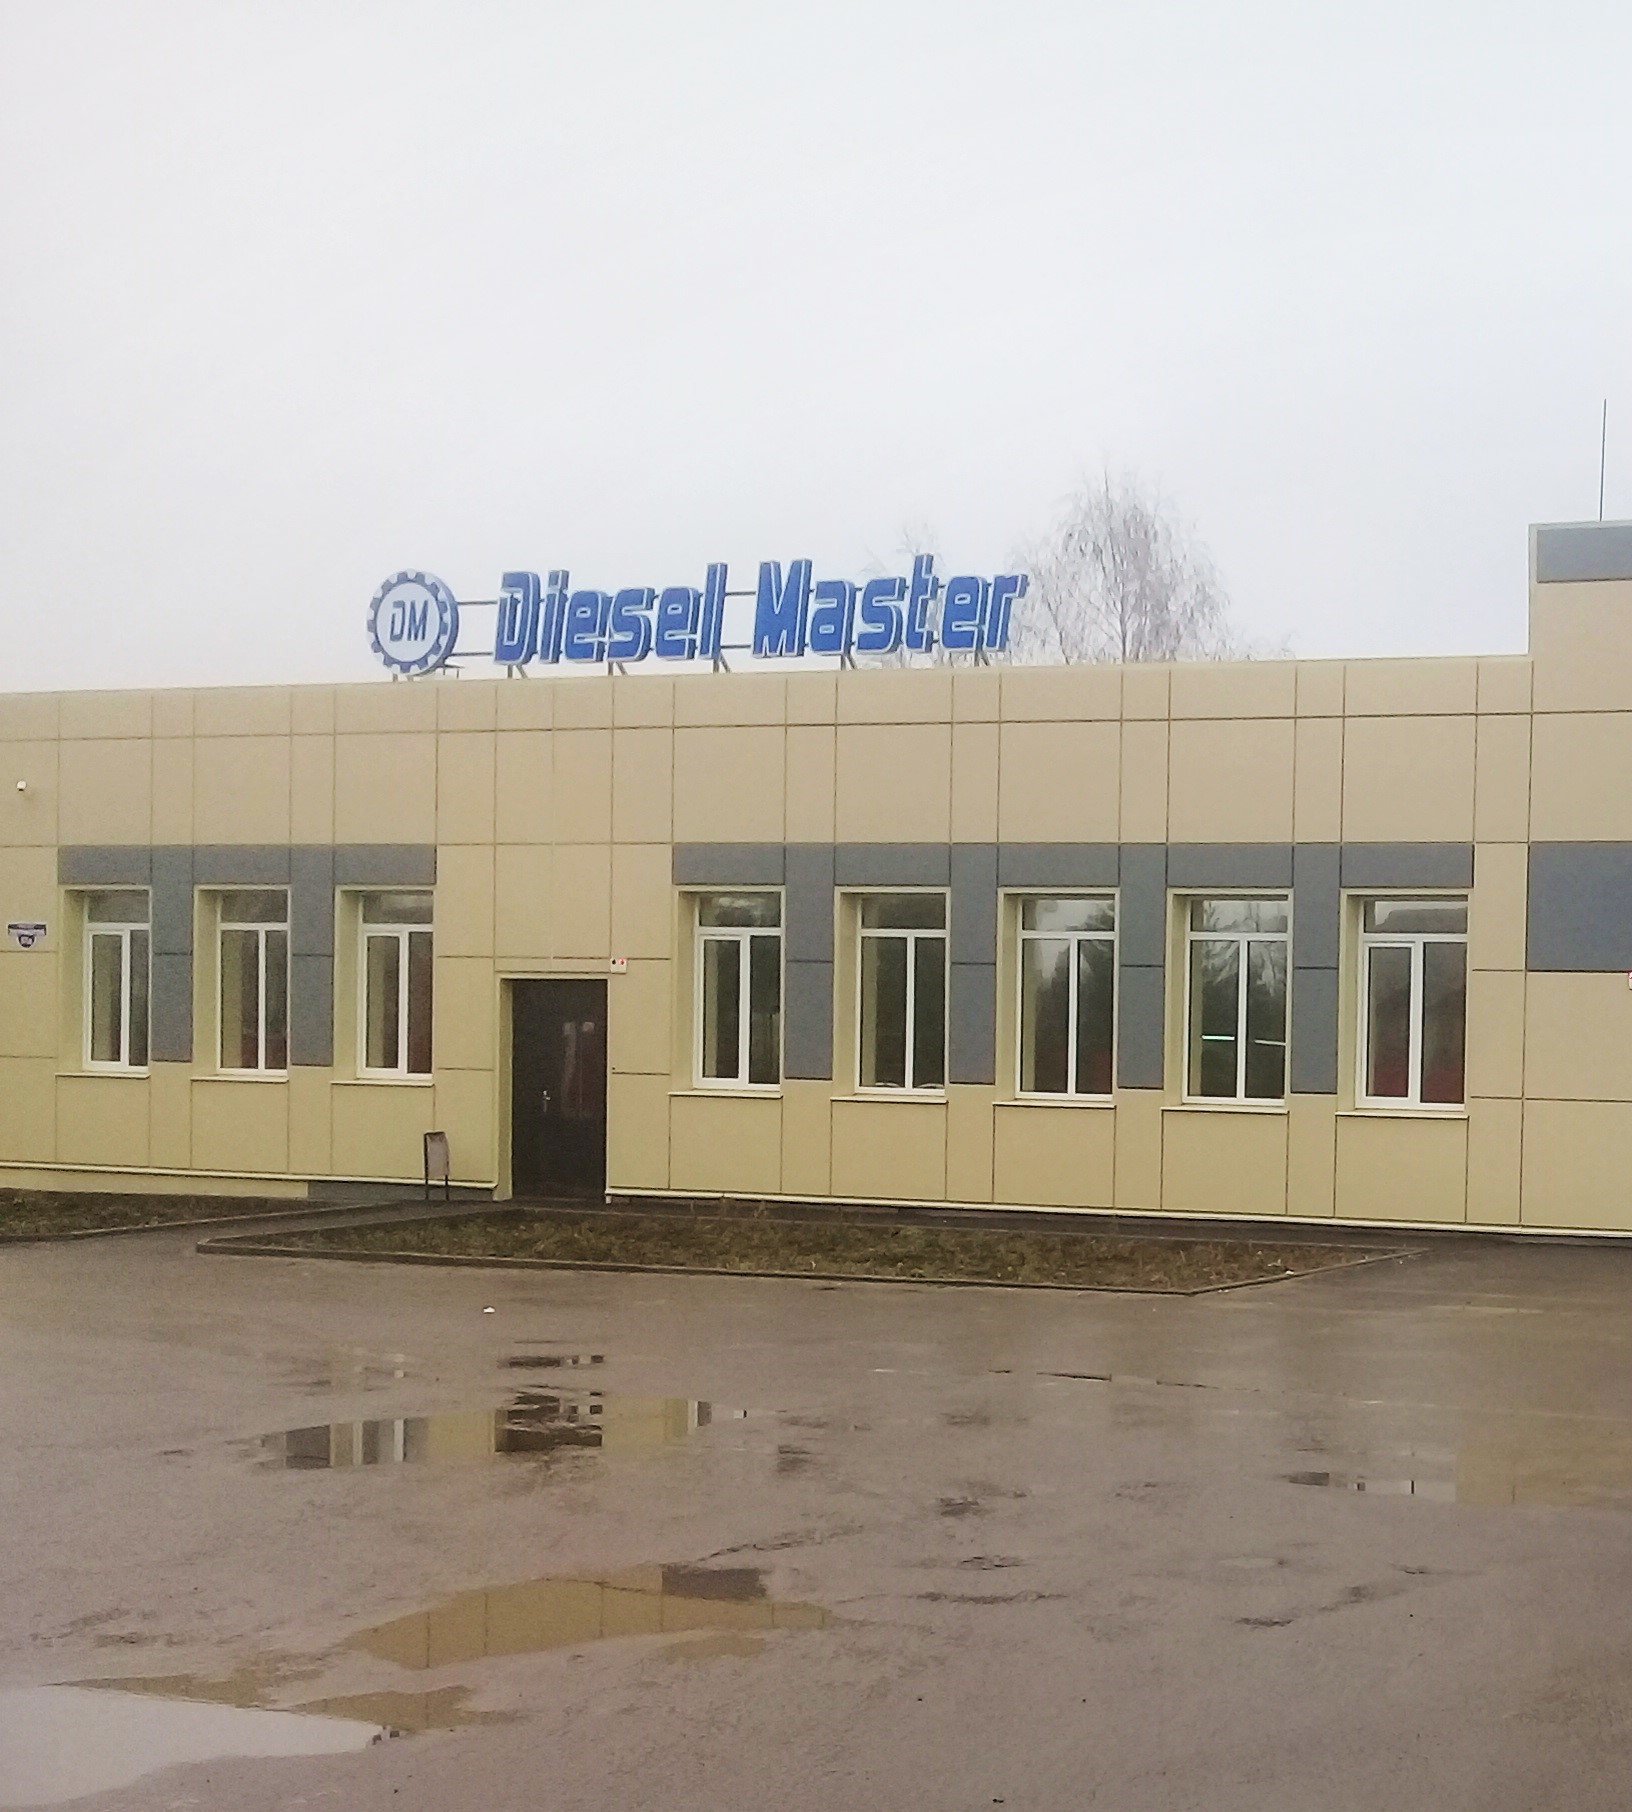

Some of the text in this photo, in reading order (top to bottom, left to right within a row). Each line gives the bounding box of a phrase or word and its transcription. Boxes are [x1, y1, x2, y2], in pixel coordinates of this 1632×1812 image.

[391, 600, 430, 642] DM
[494, 553, 1029, 664] Diesel Master
